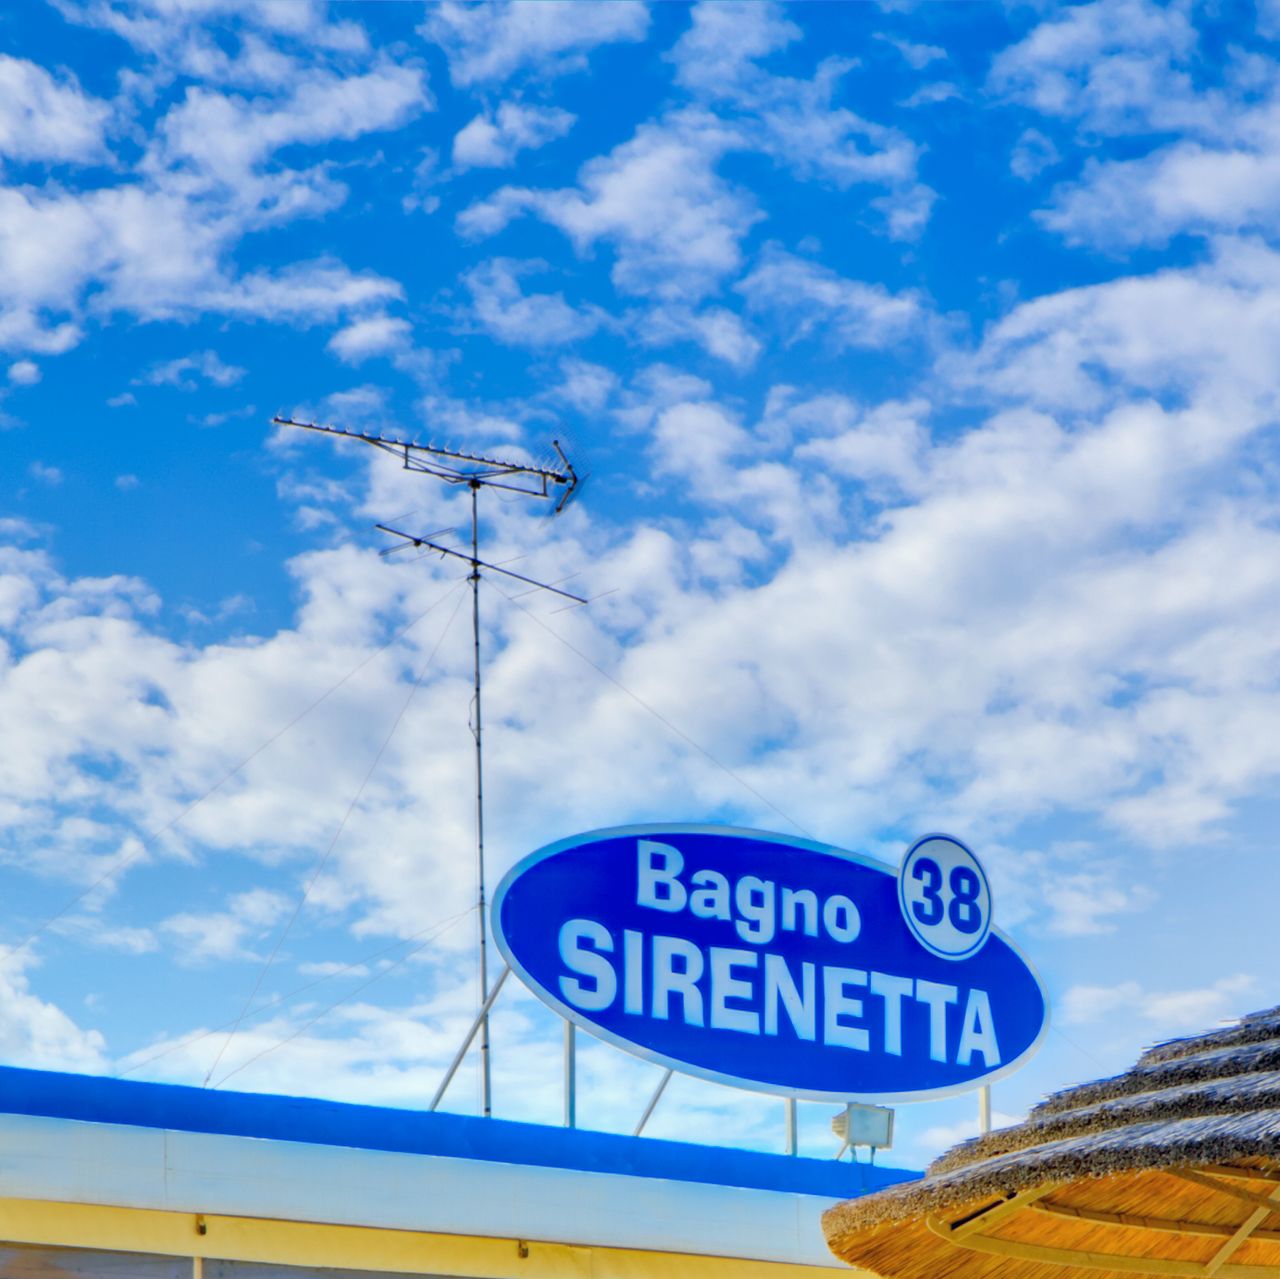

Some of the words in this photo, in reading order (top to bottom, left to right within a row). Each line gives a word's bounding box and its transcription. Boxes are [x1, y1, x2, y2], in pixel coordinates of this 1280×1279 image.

[636, 839, 861, 944] Bagno
[911, 857, 982, 935] 38
[558, 918, 1001, 1068] SIRENETTA
